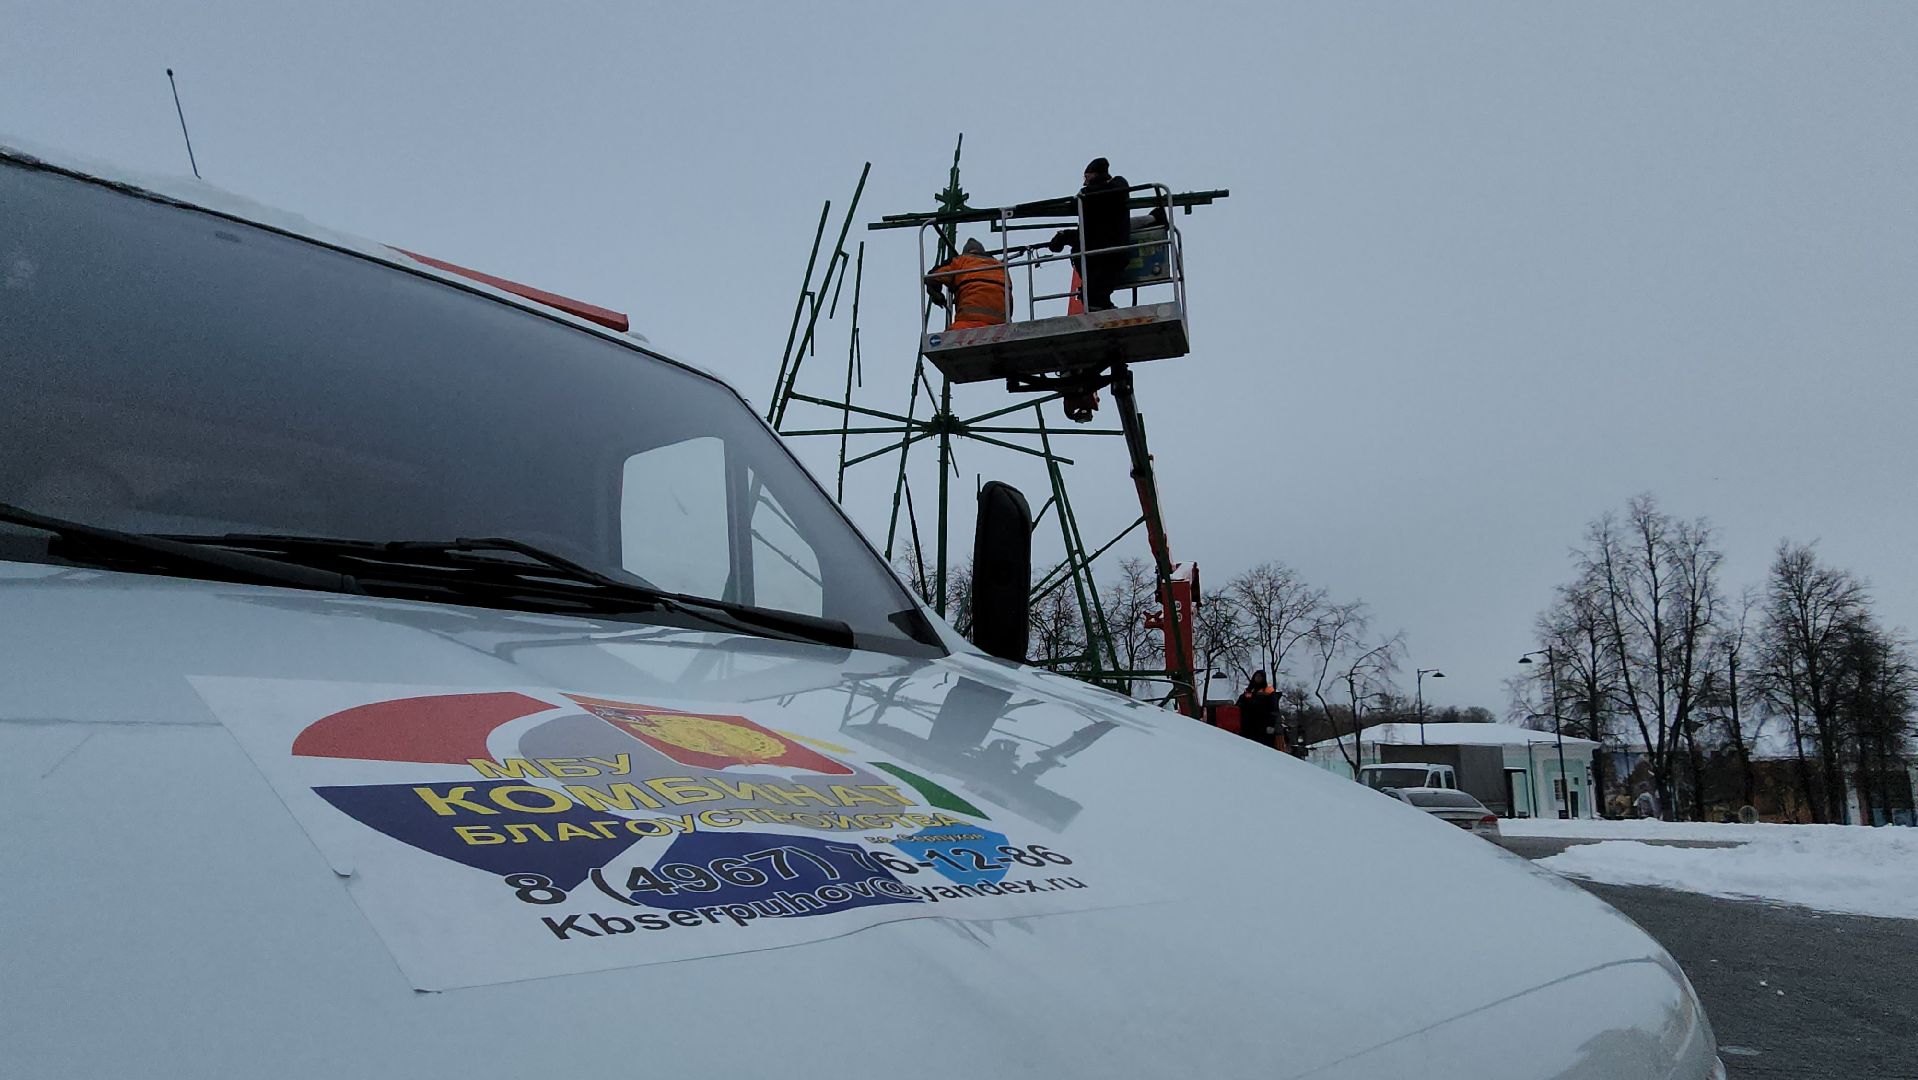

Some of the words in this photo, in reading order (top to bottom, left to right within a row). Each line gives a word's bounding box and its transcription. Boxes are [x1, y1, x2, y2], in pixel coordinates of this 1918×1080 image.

[466, 752, 632, 780] МБУ
[411, 776, 920, 816] КОМБИНАТ
[452, 808, 973, 846] БЛАГОУСТРОЙСТВА
[504, 872, 568, 905] 8
[587, 845, 841, 907] (4967)
[824, 845, 1074, 875] 76-12-86
[541, 876, 1089, 940] Kbserpuhov@yandex.ru
